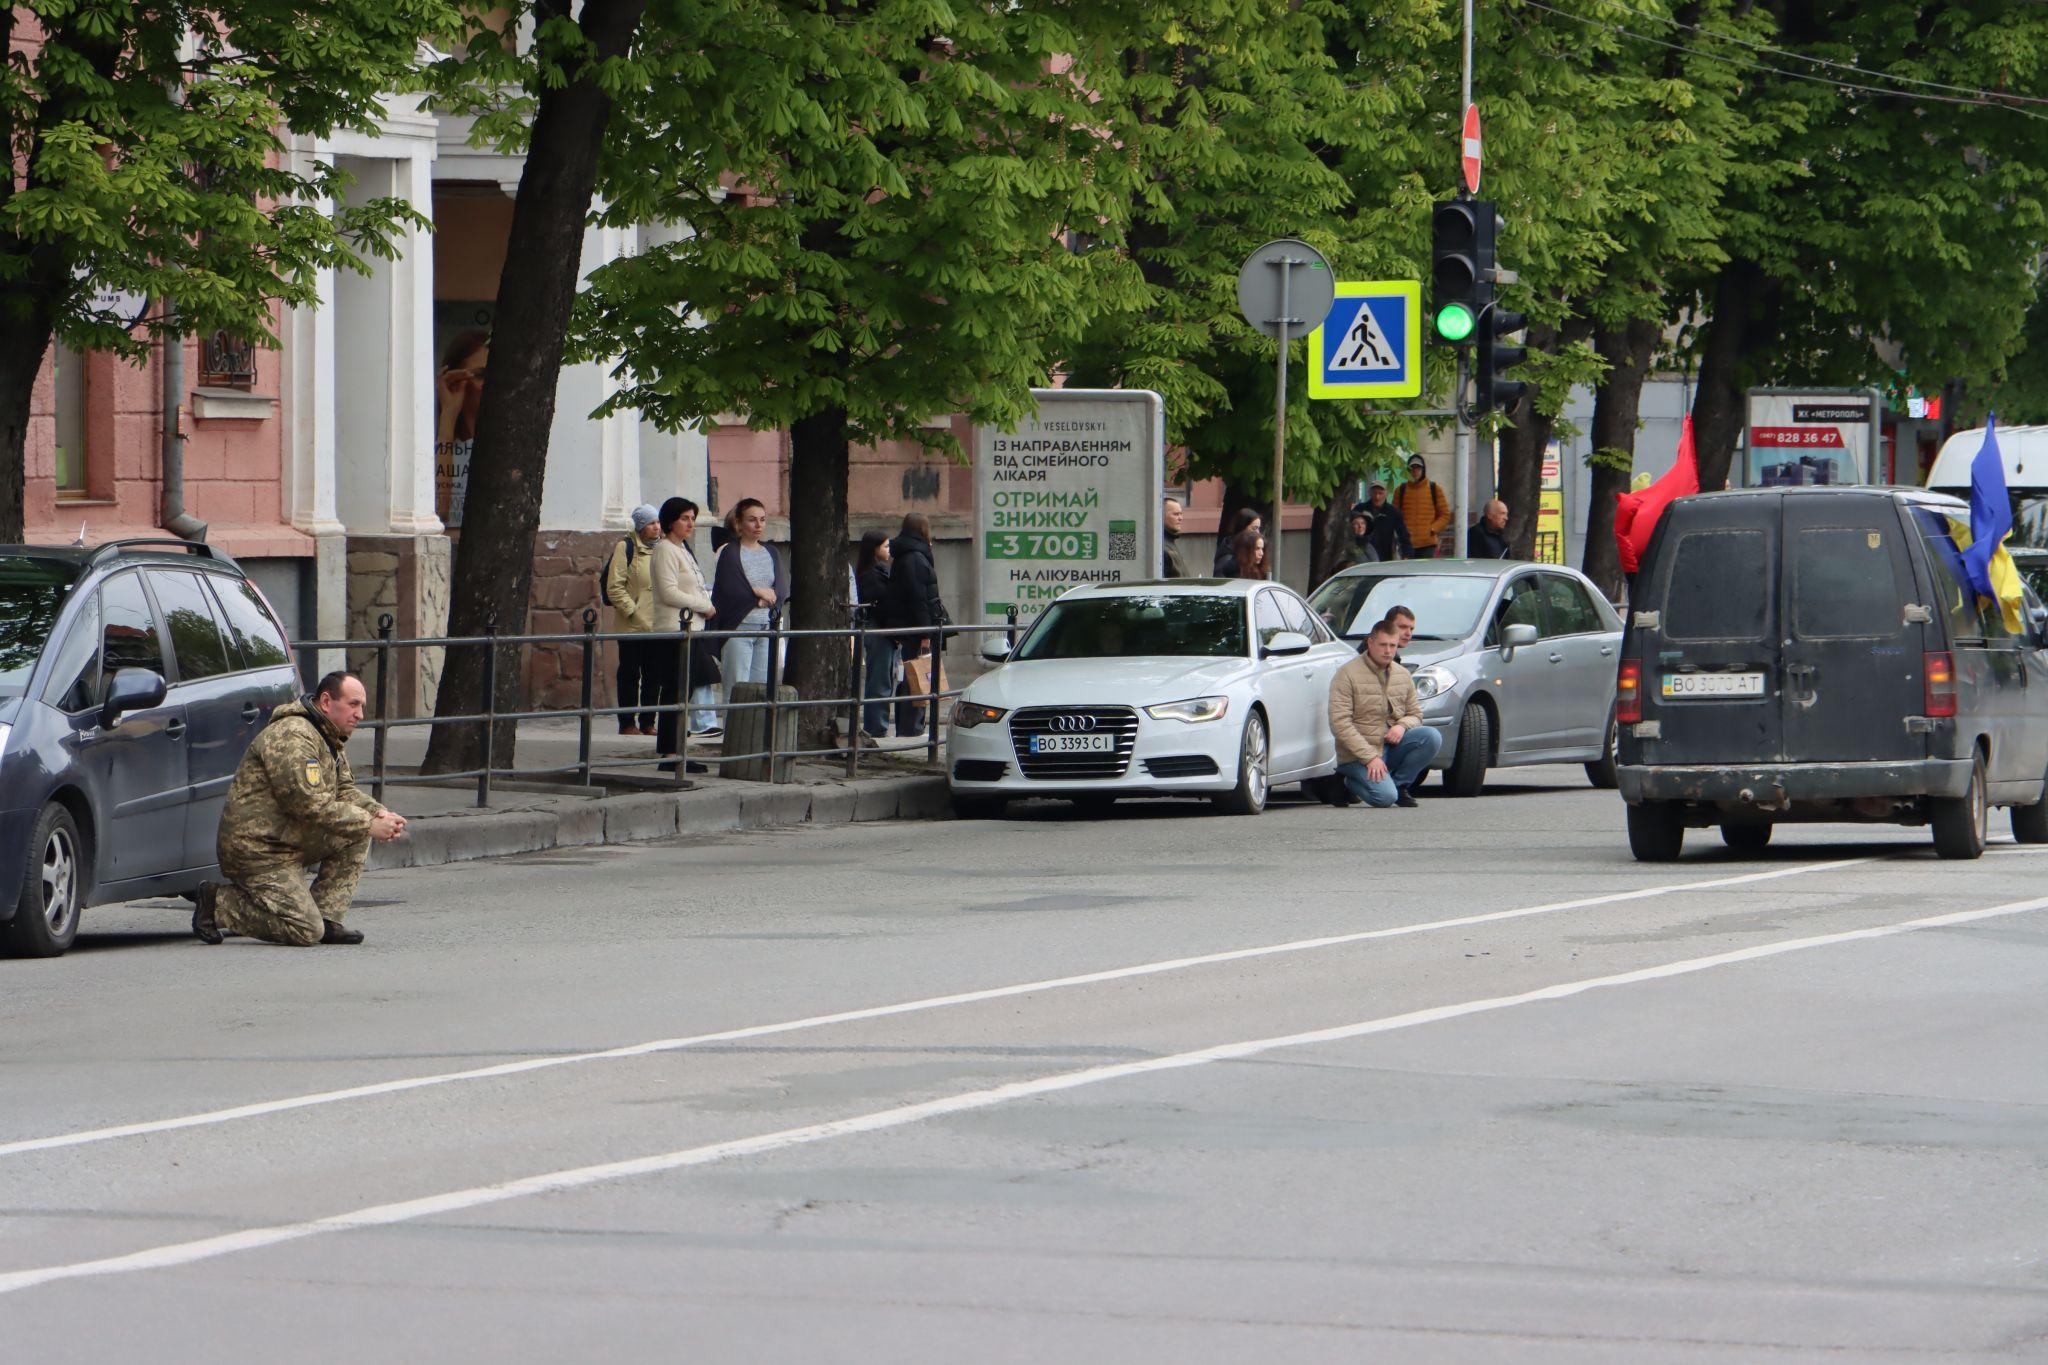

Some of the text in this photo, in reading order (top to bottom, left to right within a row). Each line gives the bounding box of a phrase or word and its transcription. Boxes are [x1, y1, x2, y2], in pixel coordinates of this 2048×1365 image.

[1798, 410, 1864, 418] ЖК «МЕТРОПОЛЬ»
[1044, 422, 1106, 431] VESELOVSKYI
[1777, 433, 1799, 443] 828
[1803, 433, 1818, 443] 36
[1821, 433, 1837, 443] 47
[993, 440, 1131, 452] ІЗ НАПРАВЛЕННЯМ
[993, 452, 1109, 468] ВІД СІМЕЙНОГО
[993, 470, 1046, 481] ЛІКАРЯ
[993, 488, 1098, 508] ОТРИМАЙ
[993, 511, 1088, 528] ЗНИЖКУ
[992, 533, 1093, 559] -3 700 ГРН
[1010, 570, 1121, 582] НА ЛІКУВАННЯ
[1016, 585, 1074, 599] ГЕМО
[1673, 678, 1695, 692] BO
[1738, 676, 1761, 690] AT
[1038, 737, 1108, 751] BO 3393 CI
